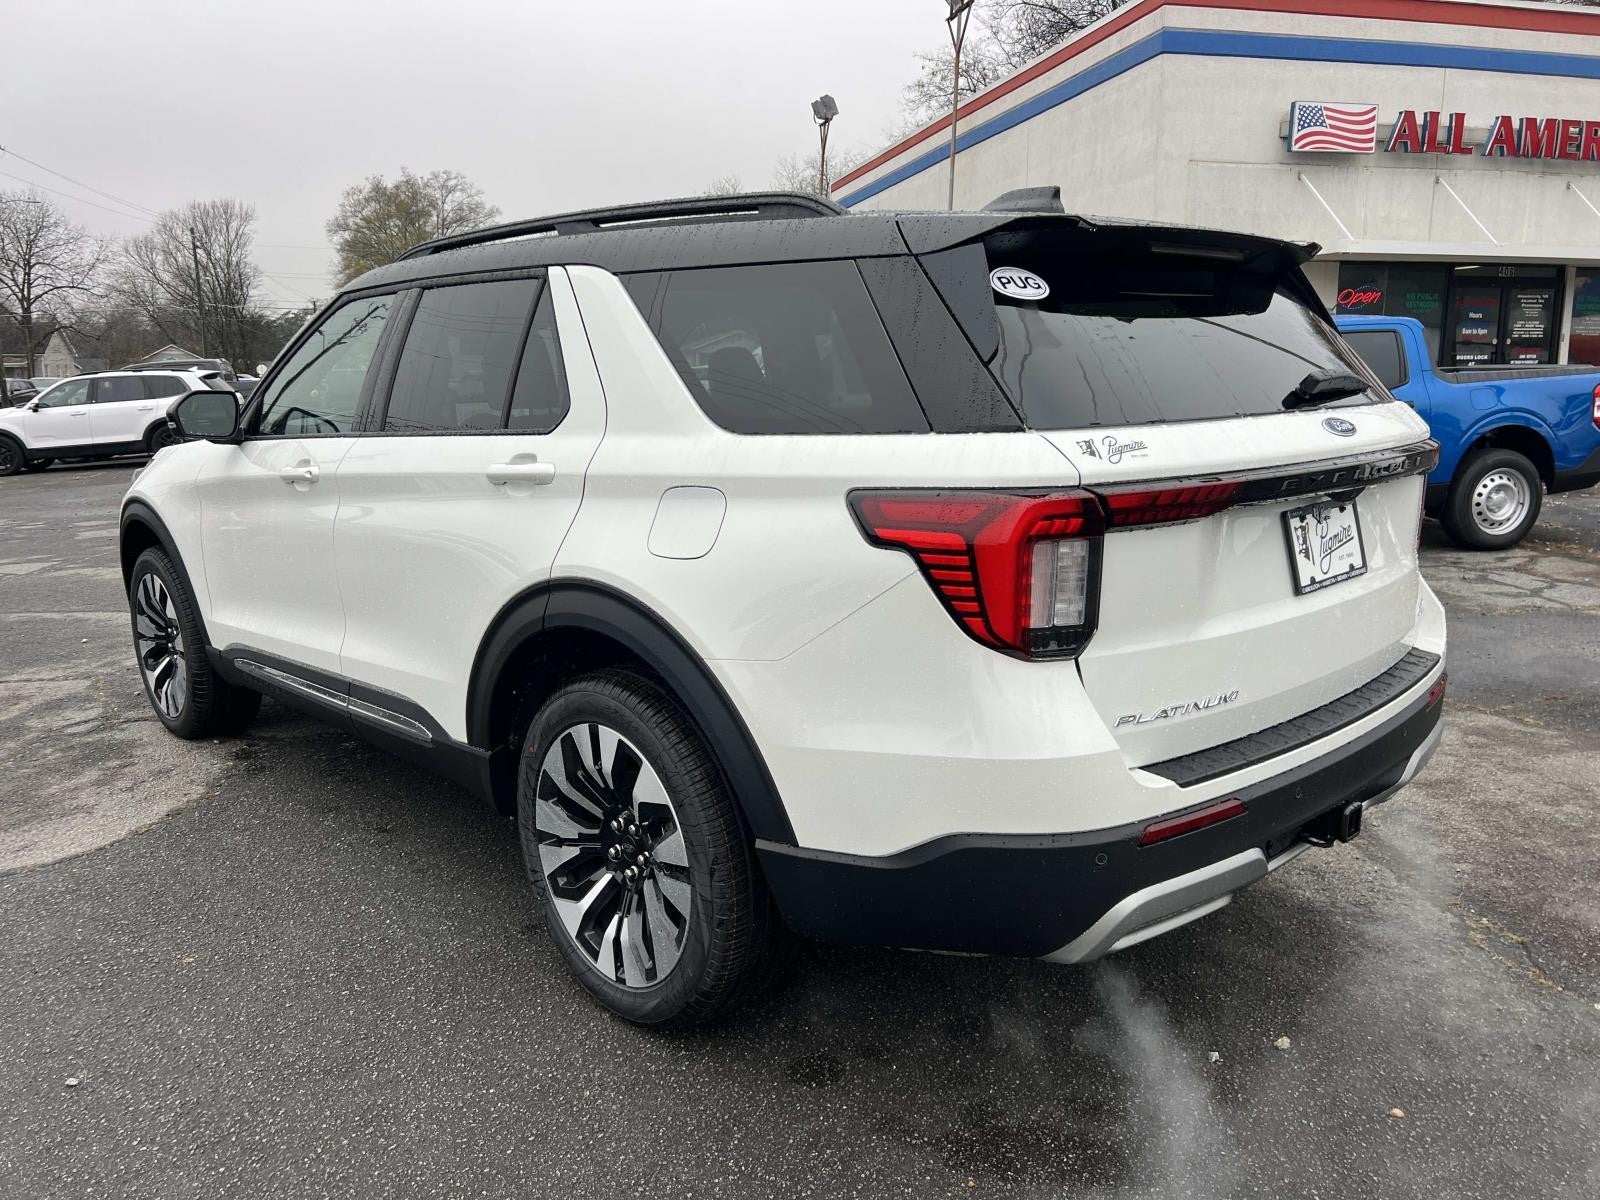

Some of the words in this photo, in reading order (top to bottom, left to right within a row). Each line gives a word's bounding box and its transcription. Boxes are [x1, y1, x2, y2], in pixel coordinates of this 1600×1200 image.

[1384, 110, 1472, 154] ALL
[996, 276, 1043, 290] PUG
[1337, 288, 1382, 308] Open
[1102, 435, 1148, 464] Pugmire
[1316, 520, 1355, 575] Pugmire
[1114, 690, 1239, 728] PLATINUM
